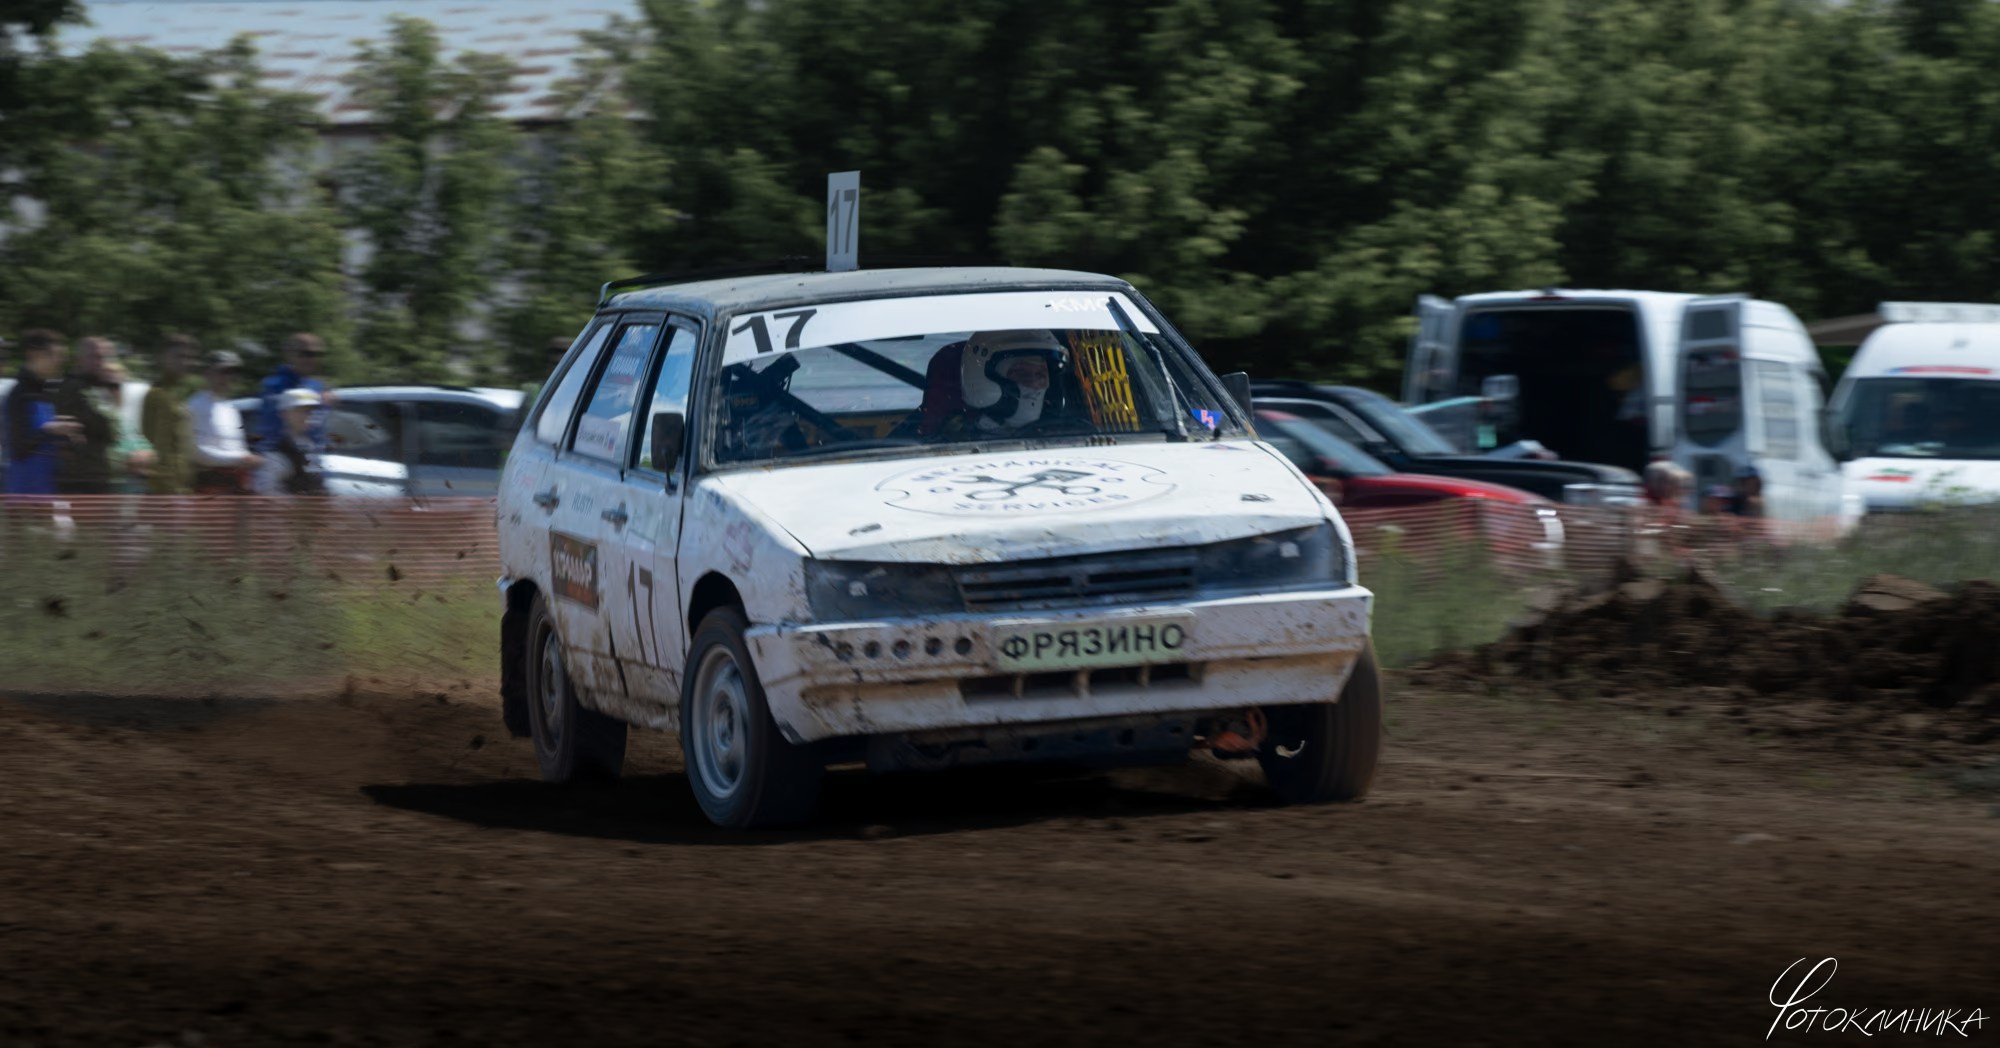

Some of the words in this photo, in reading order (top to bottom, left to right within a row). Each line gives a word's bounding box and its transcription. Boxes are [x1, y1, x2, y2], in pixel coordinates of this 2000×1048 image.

[830, 189, 857, 254] 17
[731, 309, 818, 354] 17
[627, 560, 659, 668] 17
[1001, 623, 1185, 660] ФРЯЗИНО
